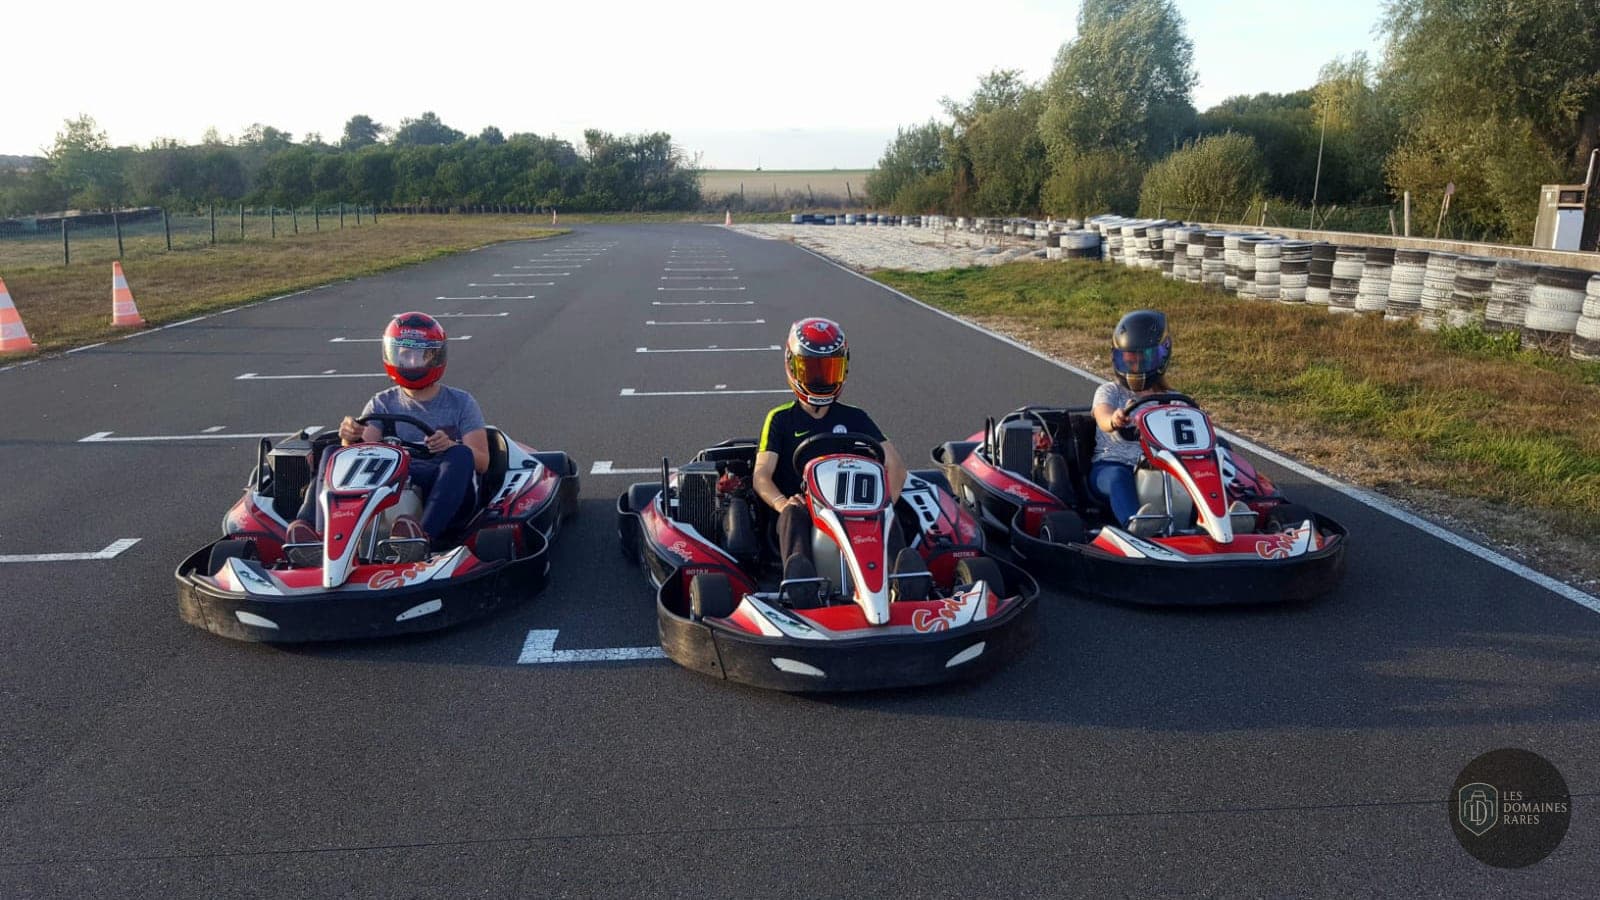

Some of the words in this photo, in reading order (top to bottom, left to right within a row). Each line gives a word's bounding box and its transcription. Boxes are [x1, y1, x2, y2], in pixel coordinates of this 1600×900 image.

[1172, 418, 1197, 446] 6
[338, 457, 398, 487] 14
[834, 470, 878, 506] 10
